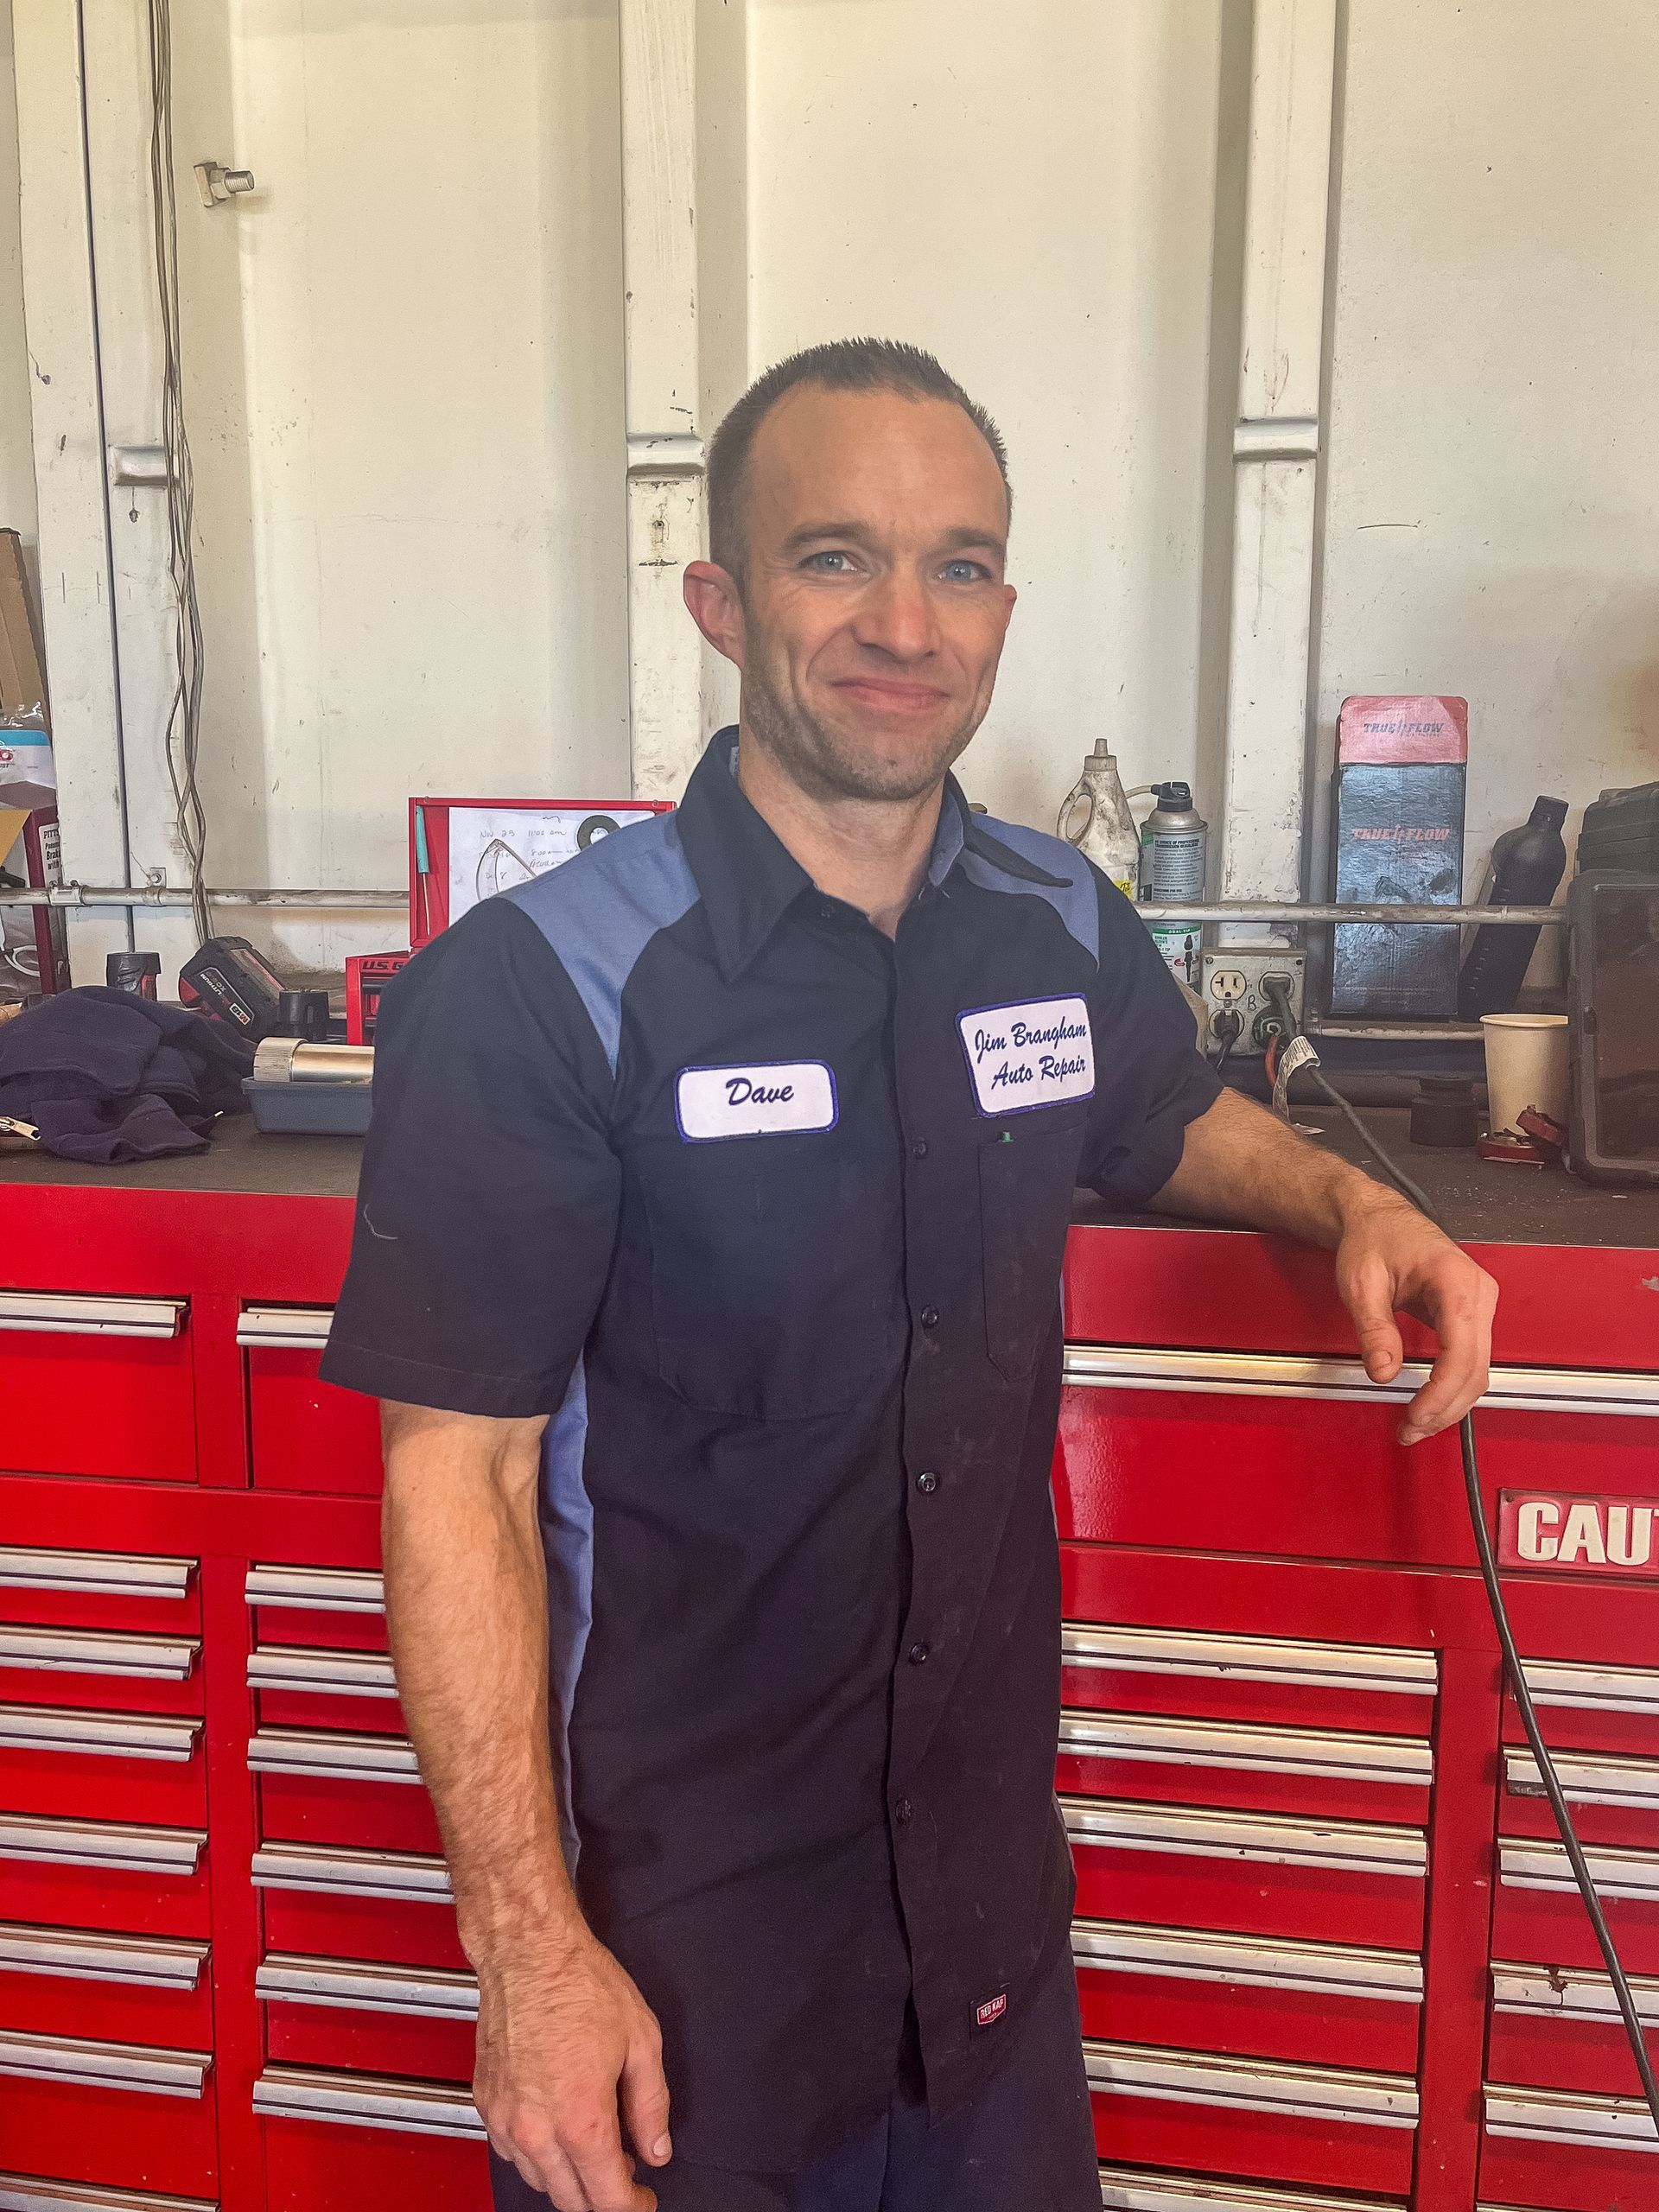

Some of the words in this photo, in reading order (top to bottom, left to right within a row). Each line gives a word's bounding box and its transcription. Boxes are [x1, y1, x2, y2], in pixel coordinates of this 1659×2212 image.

[1363, 722, 1395, 734] TRUE
[1408, 722, 1444, 734] FLOW
[1351, 828, 1393, 842] TRUE
[1405, 828, 1450, 842] FLOW
[231, 1005, 250, 1025] M18
[974, 1028, 1007, 1065] Jim
[1010, 1015, 1087, 1050] Brangham
[991, 1061, 1033, 1090] Auto
[1038, 1054, 1086, 1084] Repair
[725, 1077, 795, 1106] Dave
[1517, 1502, 1659, 1567] CAU
[980, 2005, 992, 2019] RED
[992, 1998, 1004, 2012] KAP
